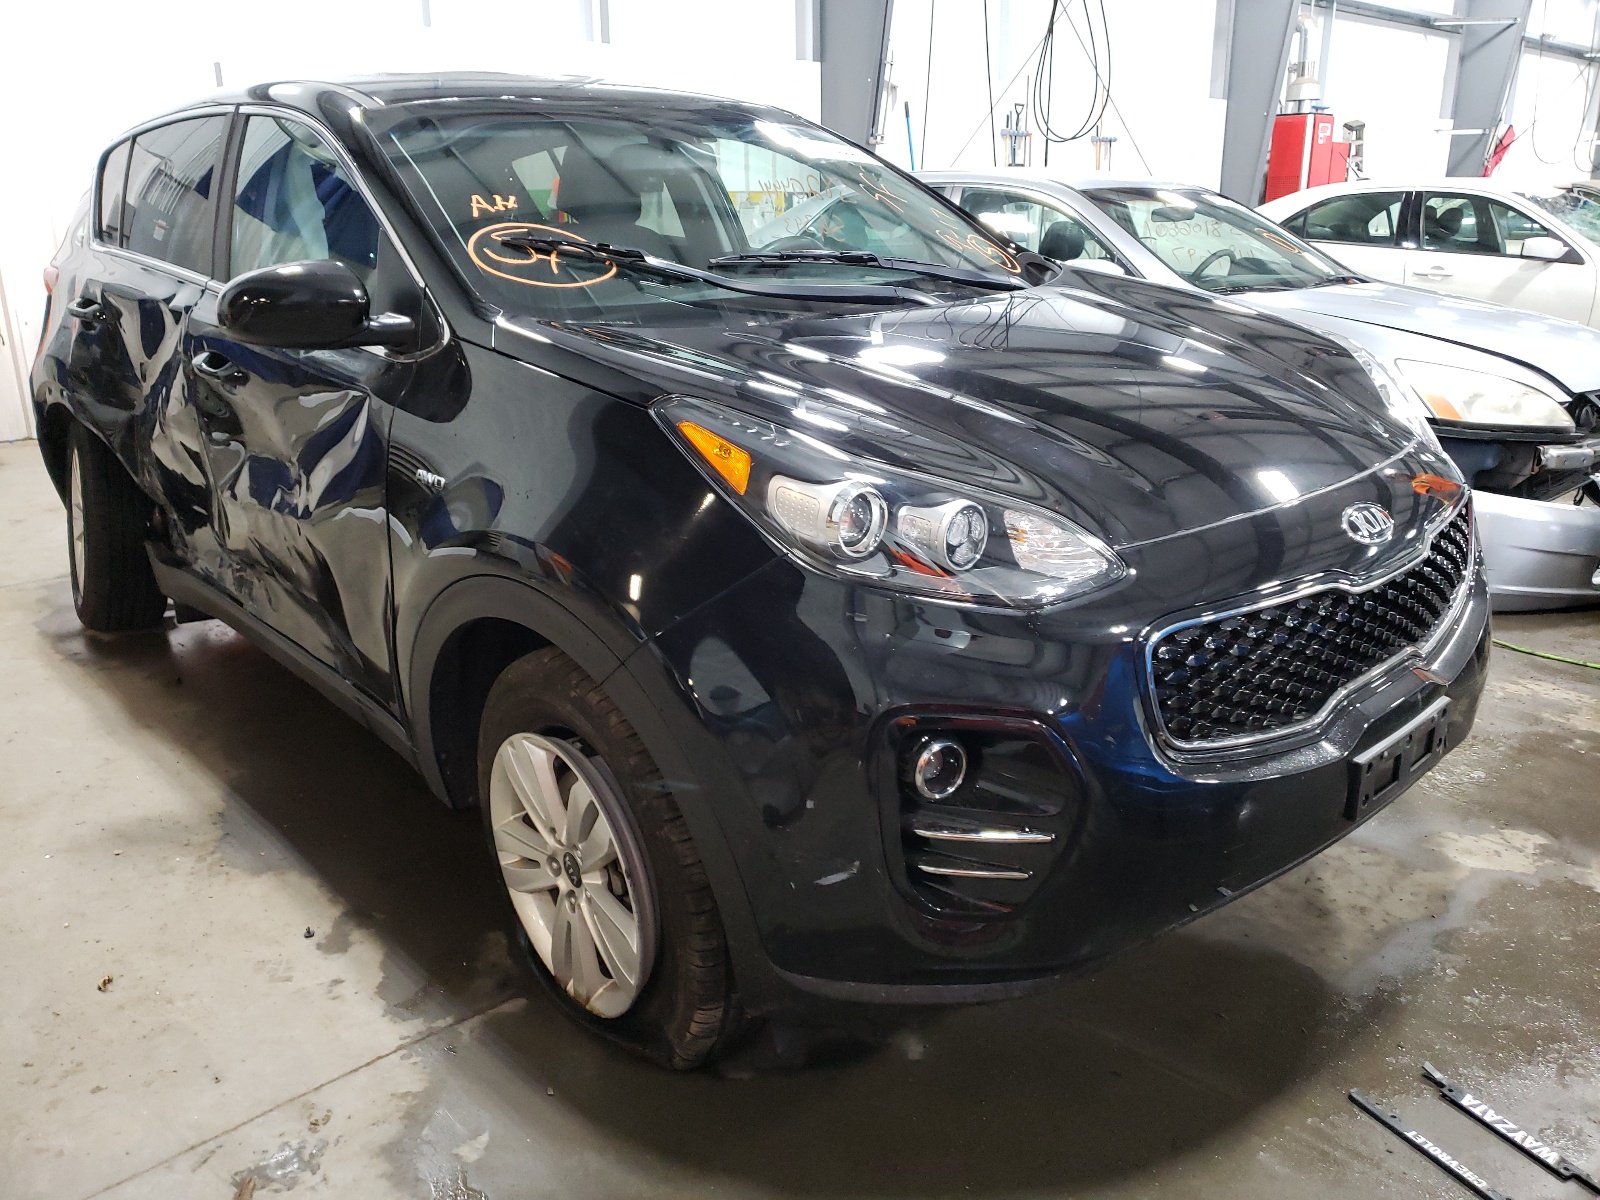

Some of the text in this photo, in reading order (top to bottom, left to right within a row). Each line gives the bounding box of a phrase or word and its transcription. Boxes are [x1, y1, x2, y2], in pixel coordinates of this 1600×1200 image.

[415, 468, 446, 491] AWD
[1349, 506, 1392, 538] KIA
[1461, 1093, 1560, 1165] WAYZATA
[1403, 1129, 1488, 1188] CHEVROLET
